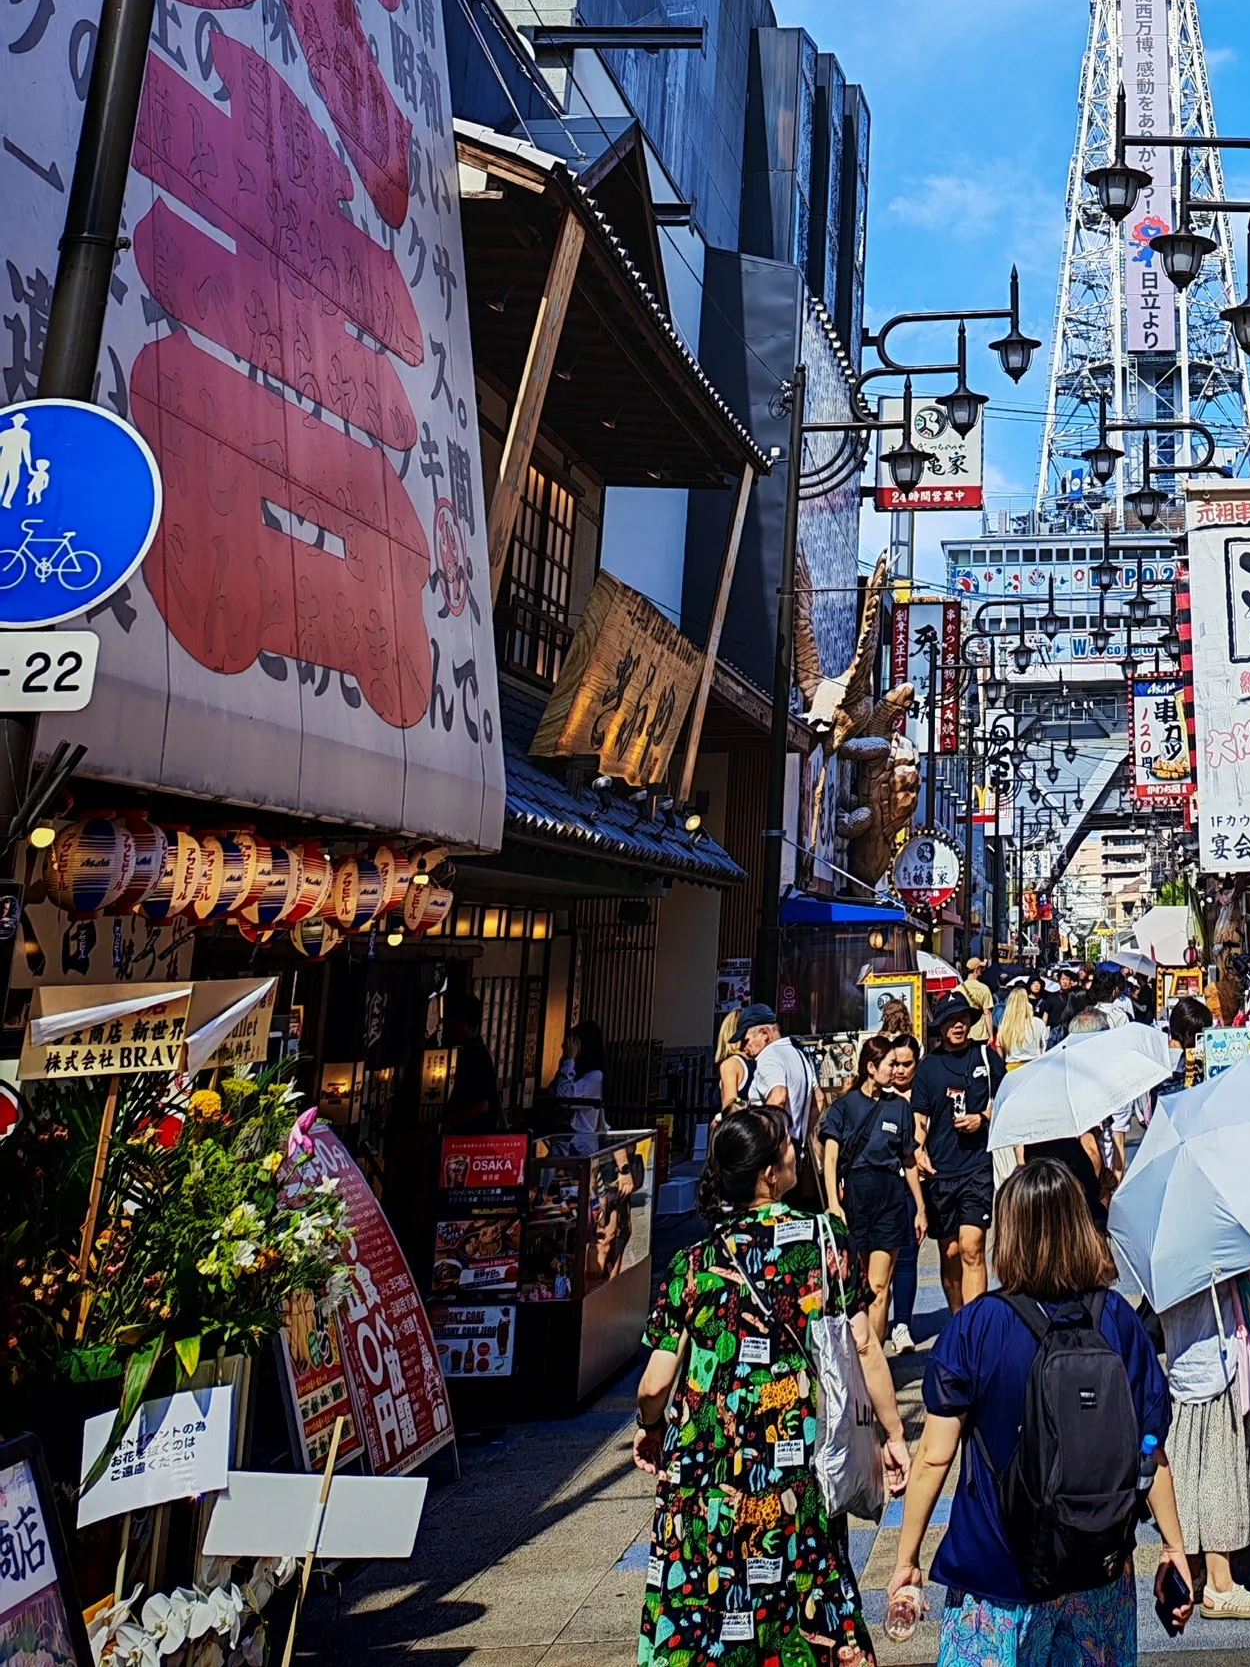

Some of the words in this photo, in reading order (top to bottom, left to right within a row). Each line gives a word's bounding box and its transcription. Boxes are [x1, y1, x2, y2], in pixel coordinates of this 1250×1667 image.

[1139, 271, 1161, 349] 日立より
[892, 490, 965, 503] 24時間営業中
[1072, 636, 1139, 659] Wecome
[1154, 698, 1183, 762] 串カツ
[80, 857, 111, 868] Asahi
[176, 847, 196, 902] アサヒビール
[340, 872, 353, 916] アサヒビール
[130, 1017, 186, 1043] 新世界
[44, 1048, 115, 1074] 株式会社
[119, 1044, 182, 1069] BRAV
[472, 1160, 513, 1171] OSAKA
